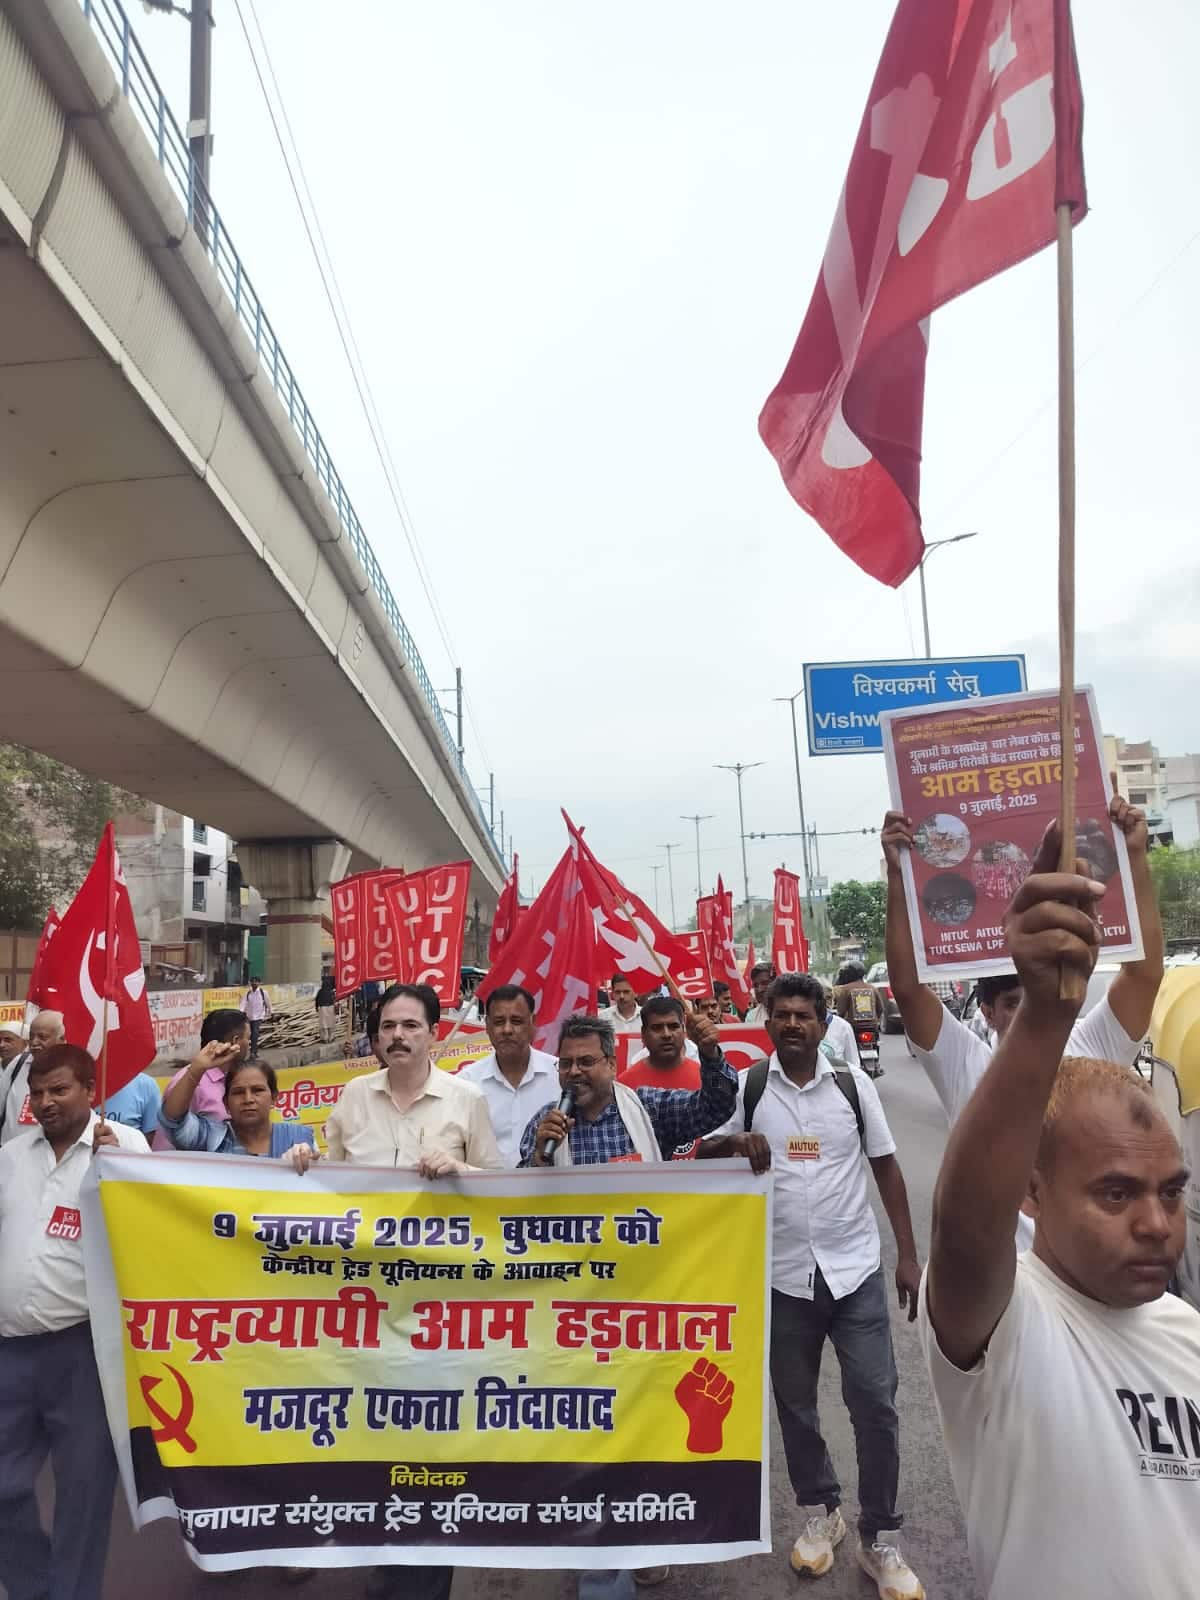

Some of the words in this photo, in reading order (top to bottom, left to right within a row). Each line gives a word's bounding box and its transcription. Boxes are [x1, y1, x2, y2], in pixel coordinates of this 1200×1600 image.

[852, 671, 936, 696] विश्वकर्मा
[945, 669, 981, 698] सेतु
[815, 711, 881, 729] Vishw
[911, 760, 928, 775] और
[1008, 749, 1038, 763] सरकार
[920, 769, 980, 798] आम
[959, 803, 967, 814] 9
[1007, 793, 1037, 808] 2025
[336, 889, 356, 987] UTUC
[776, 884, 800, 974] UTU
[940, 929, 970, 942] INTUC
[975, 926, 1004, 938] AITUC
[955, 941, 983, 953] SEWA
[274, 1079, 346, 1119] यूनिय
[789, 1141, 819, 1152] AIUTUC
[49, 1222, 80, 1238] CITU
[213, 1213, 237, 1238] 9
[252, 1209, 362, 1251] जुलाई
[374, 1216, 484, 1251] 2025,
[500, 1215, 605, 1255] बुधवार
[613, 1208, 663, 1245] को
[261, 1253, 335, 1276] केन्द्रीय
[341, 1256, 373, 1281] ट्रेड
[378, 1258, 466, 1287] यूनियन्स
[472, 1258, 495, 1280] के
[589, 1260, 616, 1279] पर
[122, 1286, 388, 1362] राष्ट्रव्यापी
[410, 1300, 534, 1351] आम
[551, 1300, 737, 1363] हड़ताल
[243, 1387, 354, 1448] मजदूर
[364, 1387, 464, 1431] एकता
[474, 1375, 617, 1431] जिंदाबाद
[390, 1465, 468, 1487] निवेदक
[285, 1494, 379, 1535] संयुक्त
[384, 1494, 424, 1532] ट्रेड
[431, 1493, 531, 1534] यूनियन
[537, 1493, 605, 1523] संघर्ष
[611, 1493, 697, 1522] समिति
